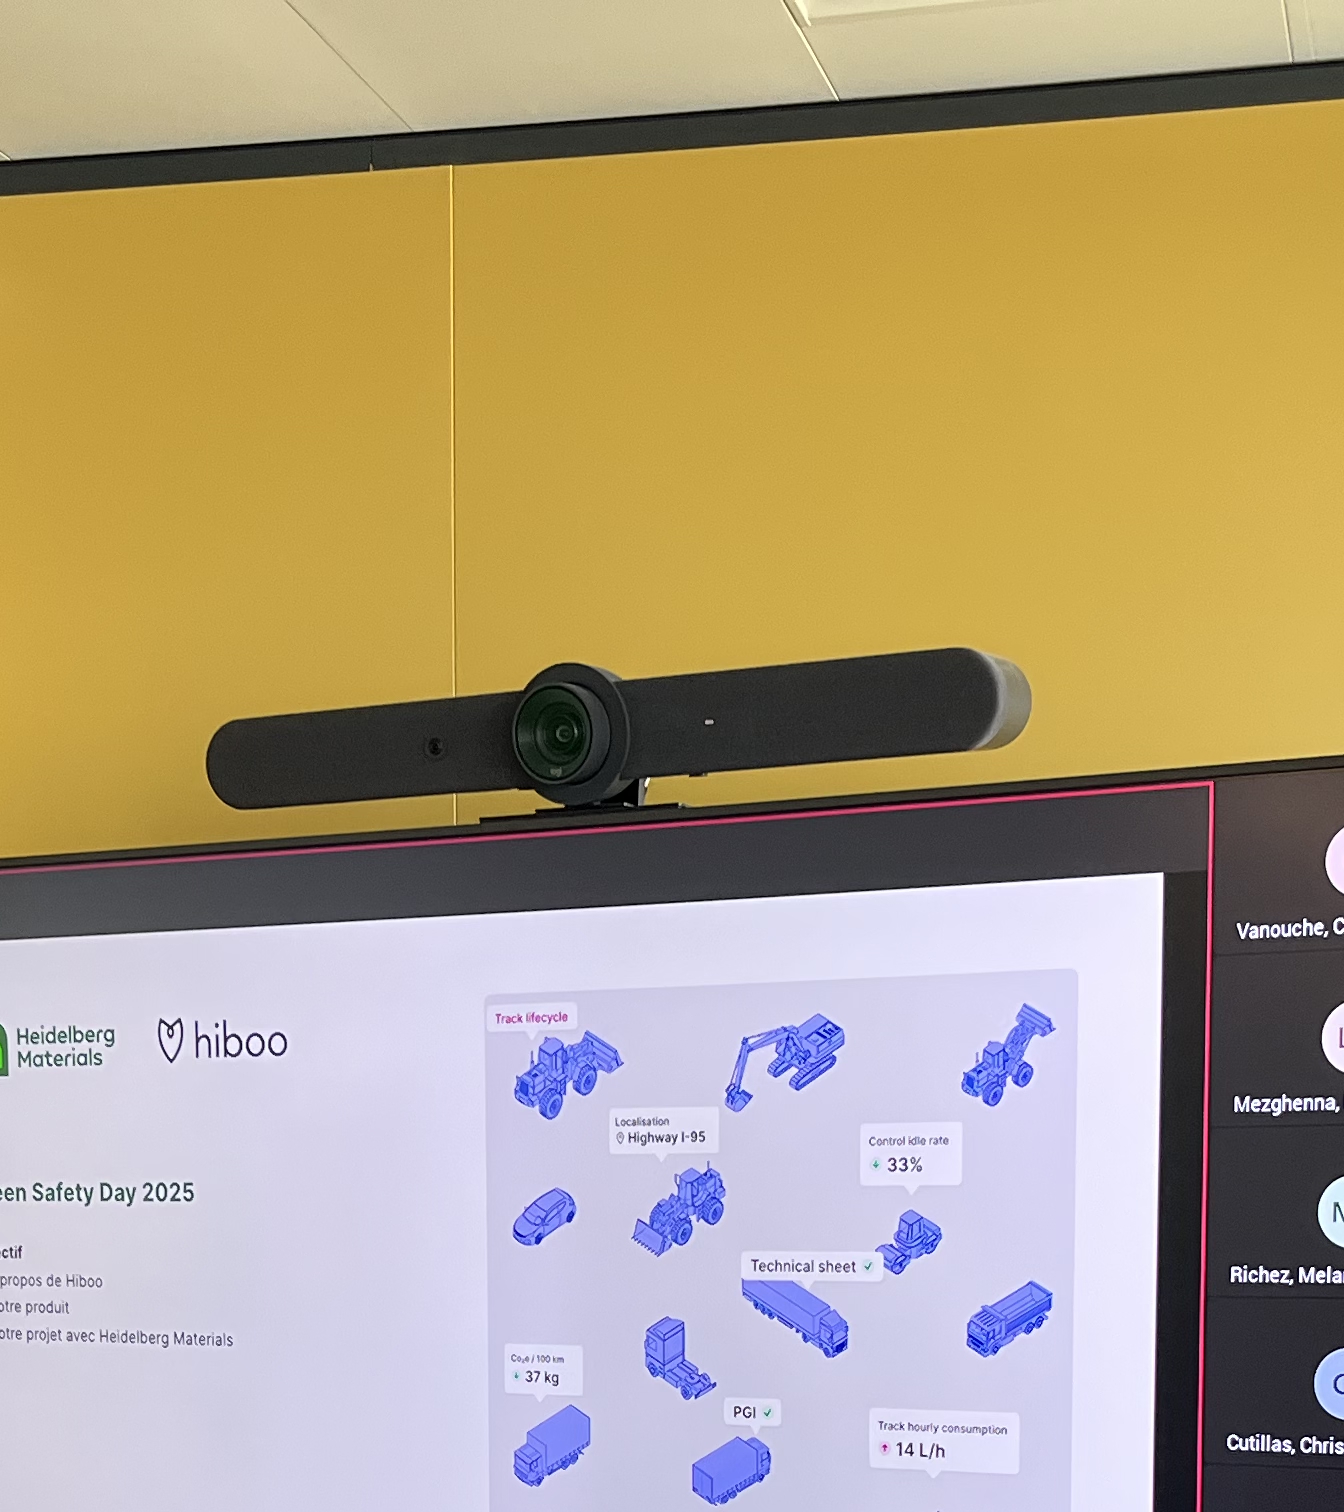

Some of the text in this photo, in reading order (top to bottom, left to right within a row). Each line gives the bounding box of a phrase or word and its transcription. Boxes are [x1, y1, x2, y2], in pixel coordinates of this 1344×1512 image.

[1236, 918, 1329, 940] Vanouche,
[495, 1011, 568, 1025] Track lifecycle
[17, 1025, 115, 1047] Heidelberg
[195, 1019, 288, 1059] hiboo
[17, 1048, 103, 1068] Materials
[1233, 1094, 1340, 1116] Mezghenna,
[615, 1116, 670, 1127] Localisation
[628, 1131, 706, 1146] Highway I-95
[868, 1135, 906, 1147] Control
[928, 1136, 950, 1147] rate
[887, 1156, 923, 1173] 33%
[32, 1181, 93, 1207] Safety
[99, 1182, 136, 1207] Day
[142, 1182, 195, 1202] 2025
[751, 1259, 856, 1274] Technical sheet
[0, 1275, 42, 1289] propos
[46, 1273, 61, 1287] de
[66, 1274, 103, 1288] Hiboo
[1230, 1265, 1294, 1286] Richez,
[26, 1300, 70, 1316] produit
[26, 1327, 63, 1344] projet
[66, 1329, 95, 1343] avec
[99, 1329, 169, 1348] Heidelberg
[173, 1331, 234, 1347] Materials
[525, 1371, 560, 1387] 37 kg
[733, 1406, 757, 1419] PGI
[878, 1421, 1008, 1436] Track hourly consumption
[896, 1442, 946, 1459] 14 L/h
[1226, 1434, 1296, 1455] Cutillas,
